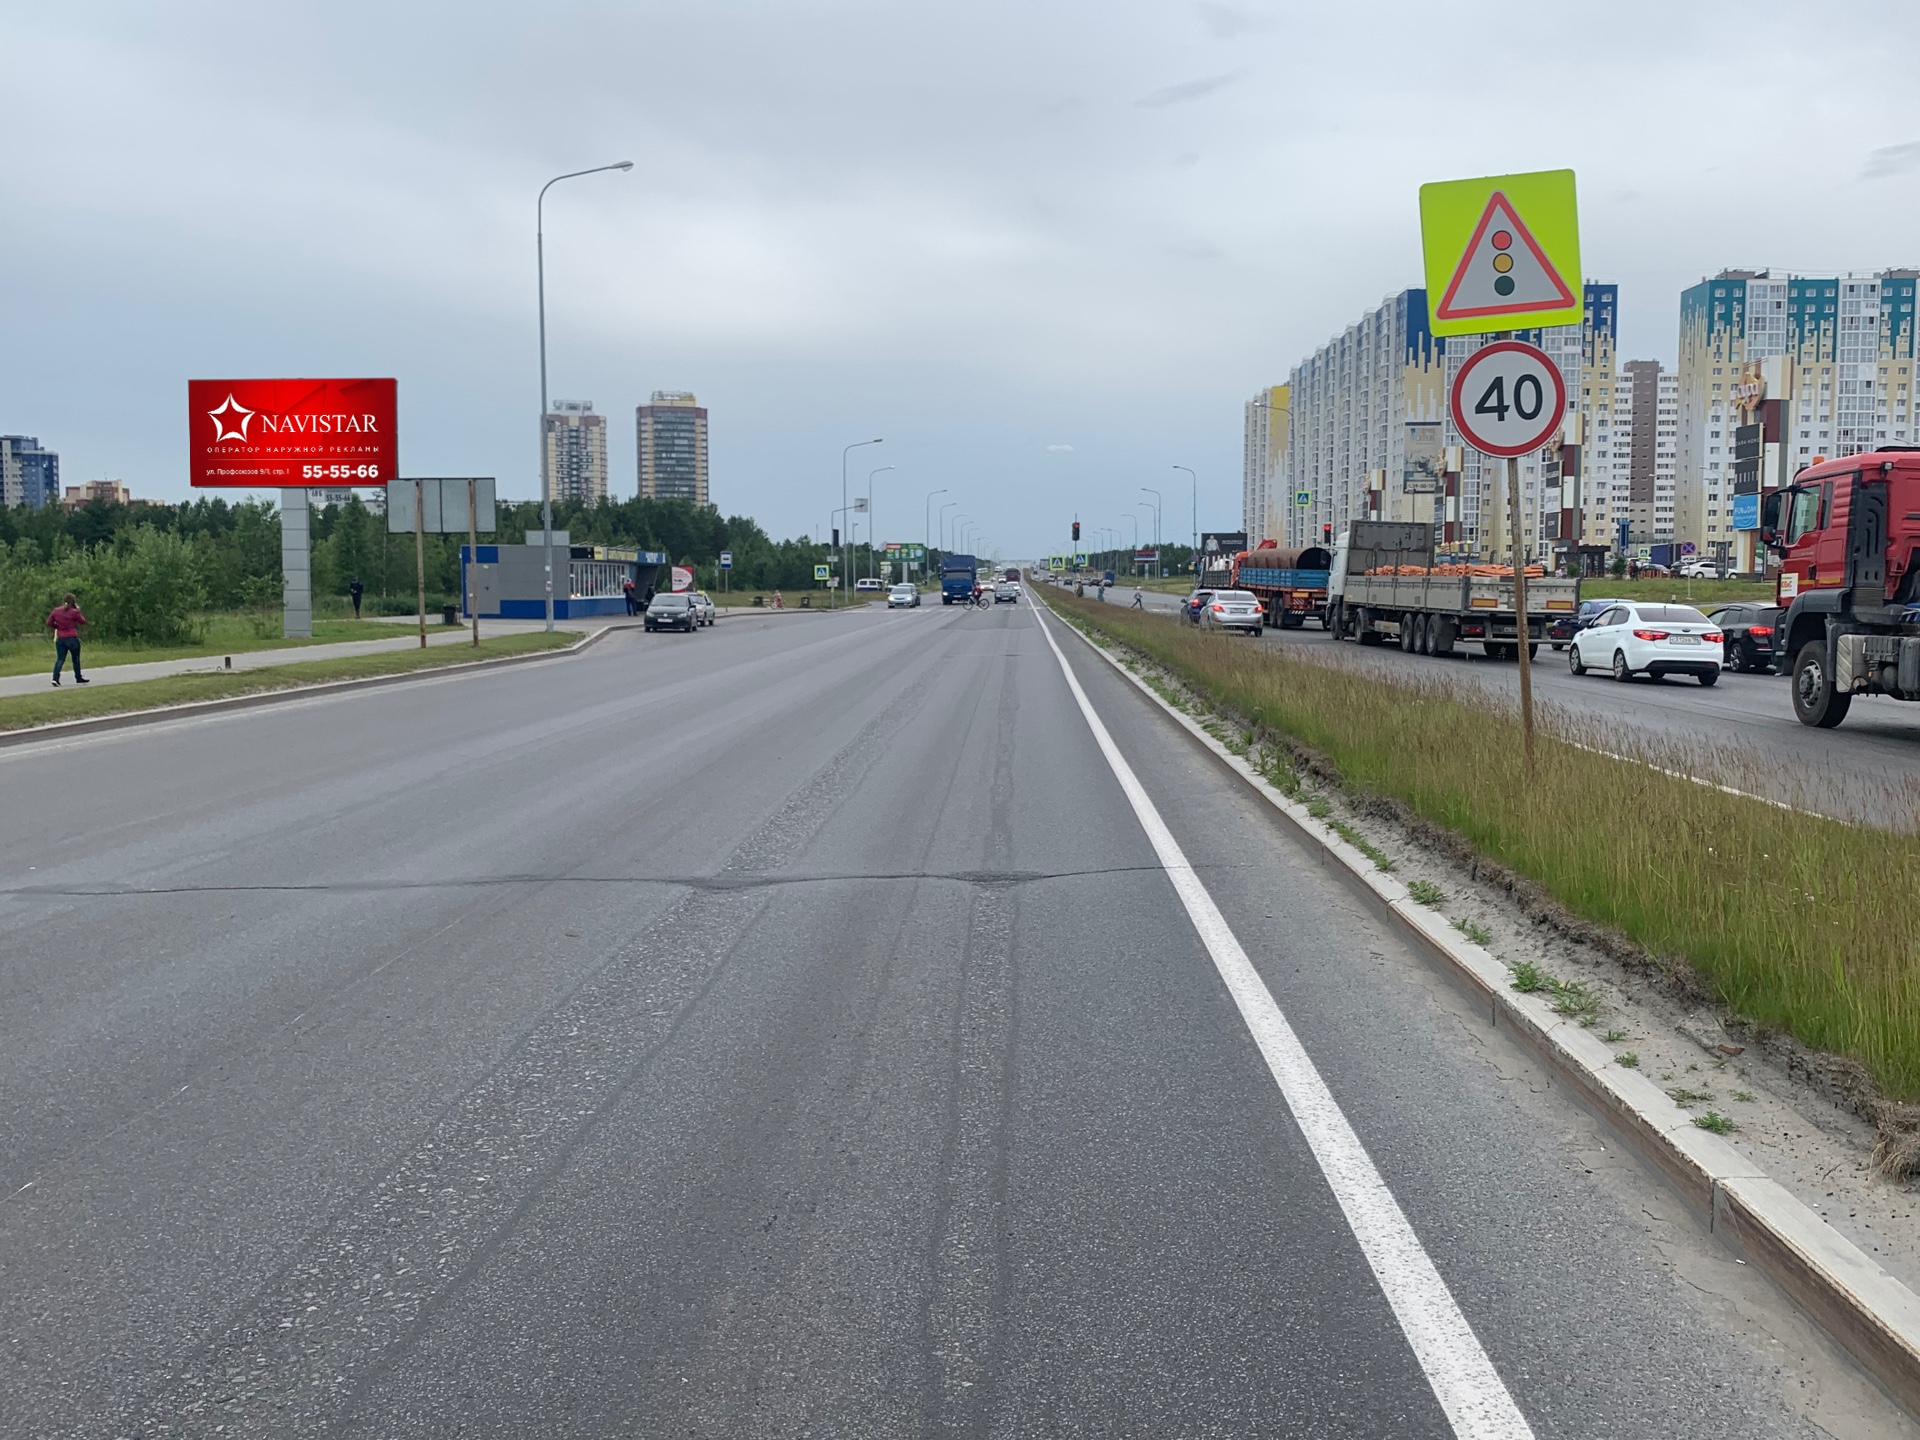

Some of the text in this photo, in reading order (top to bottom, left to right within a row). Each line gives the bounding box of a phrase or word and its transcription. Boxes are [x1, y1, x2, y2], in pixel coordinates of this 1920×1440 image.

[1474, 373, 1543, 422] 40
[261, 414, 379, 433] NAVISTAR
[206, 444, 379, 454] ОПЕРАТОР НАРУЖНОЙ РЕКЛАМЫ
[302, 464, 379, 478] 55-55-66
